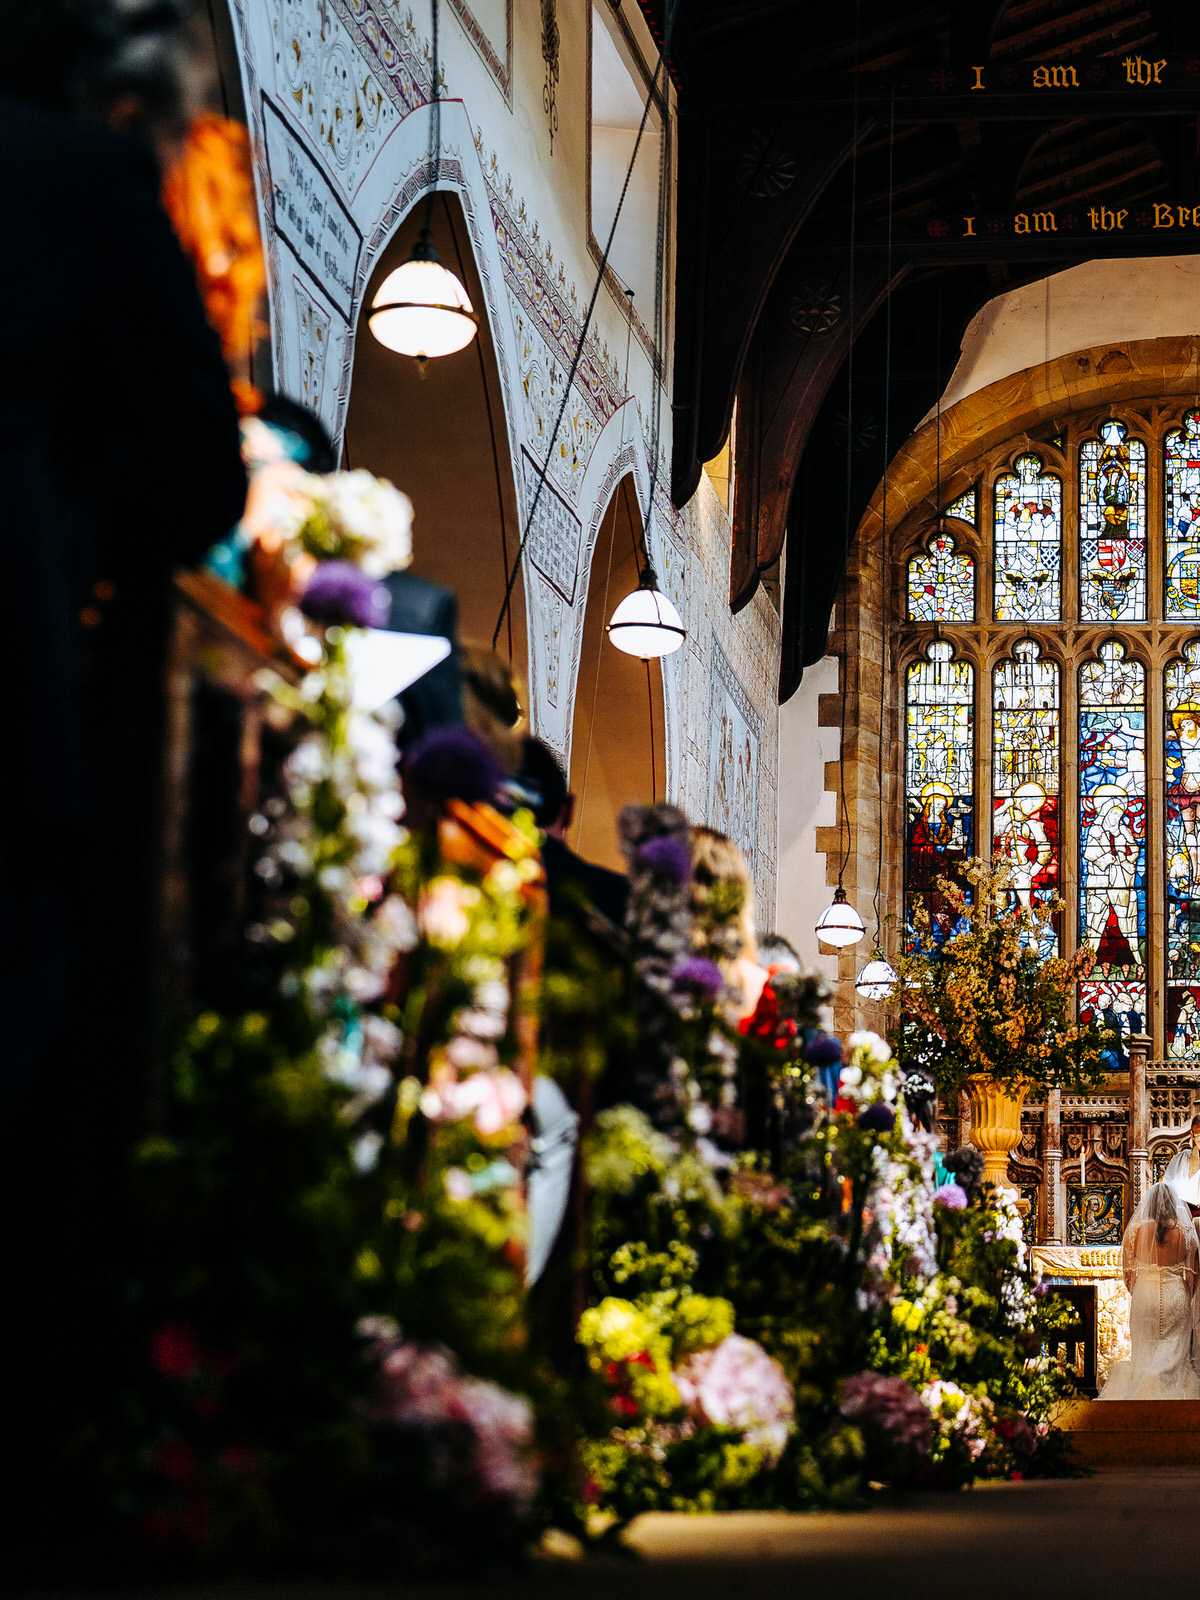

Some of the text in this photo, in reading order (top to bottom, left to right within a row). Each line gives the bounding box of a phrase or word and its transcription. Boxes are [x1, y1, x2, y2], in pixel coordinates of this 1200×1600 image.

[971, 66, 985, 90] I
[1032, 65, 1081, 88] am
[1121, 55, 1167, 85] the
[963, 217, 977, 236] I
[1014, 211, 1058, 235] am
[1087, 206, 1129, 231] the
